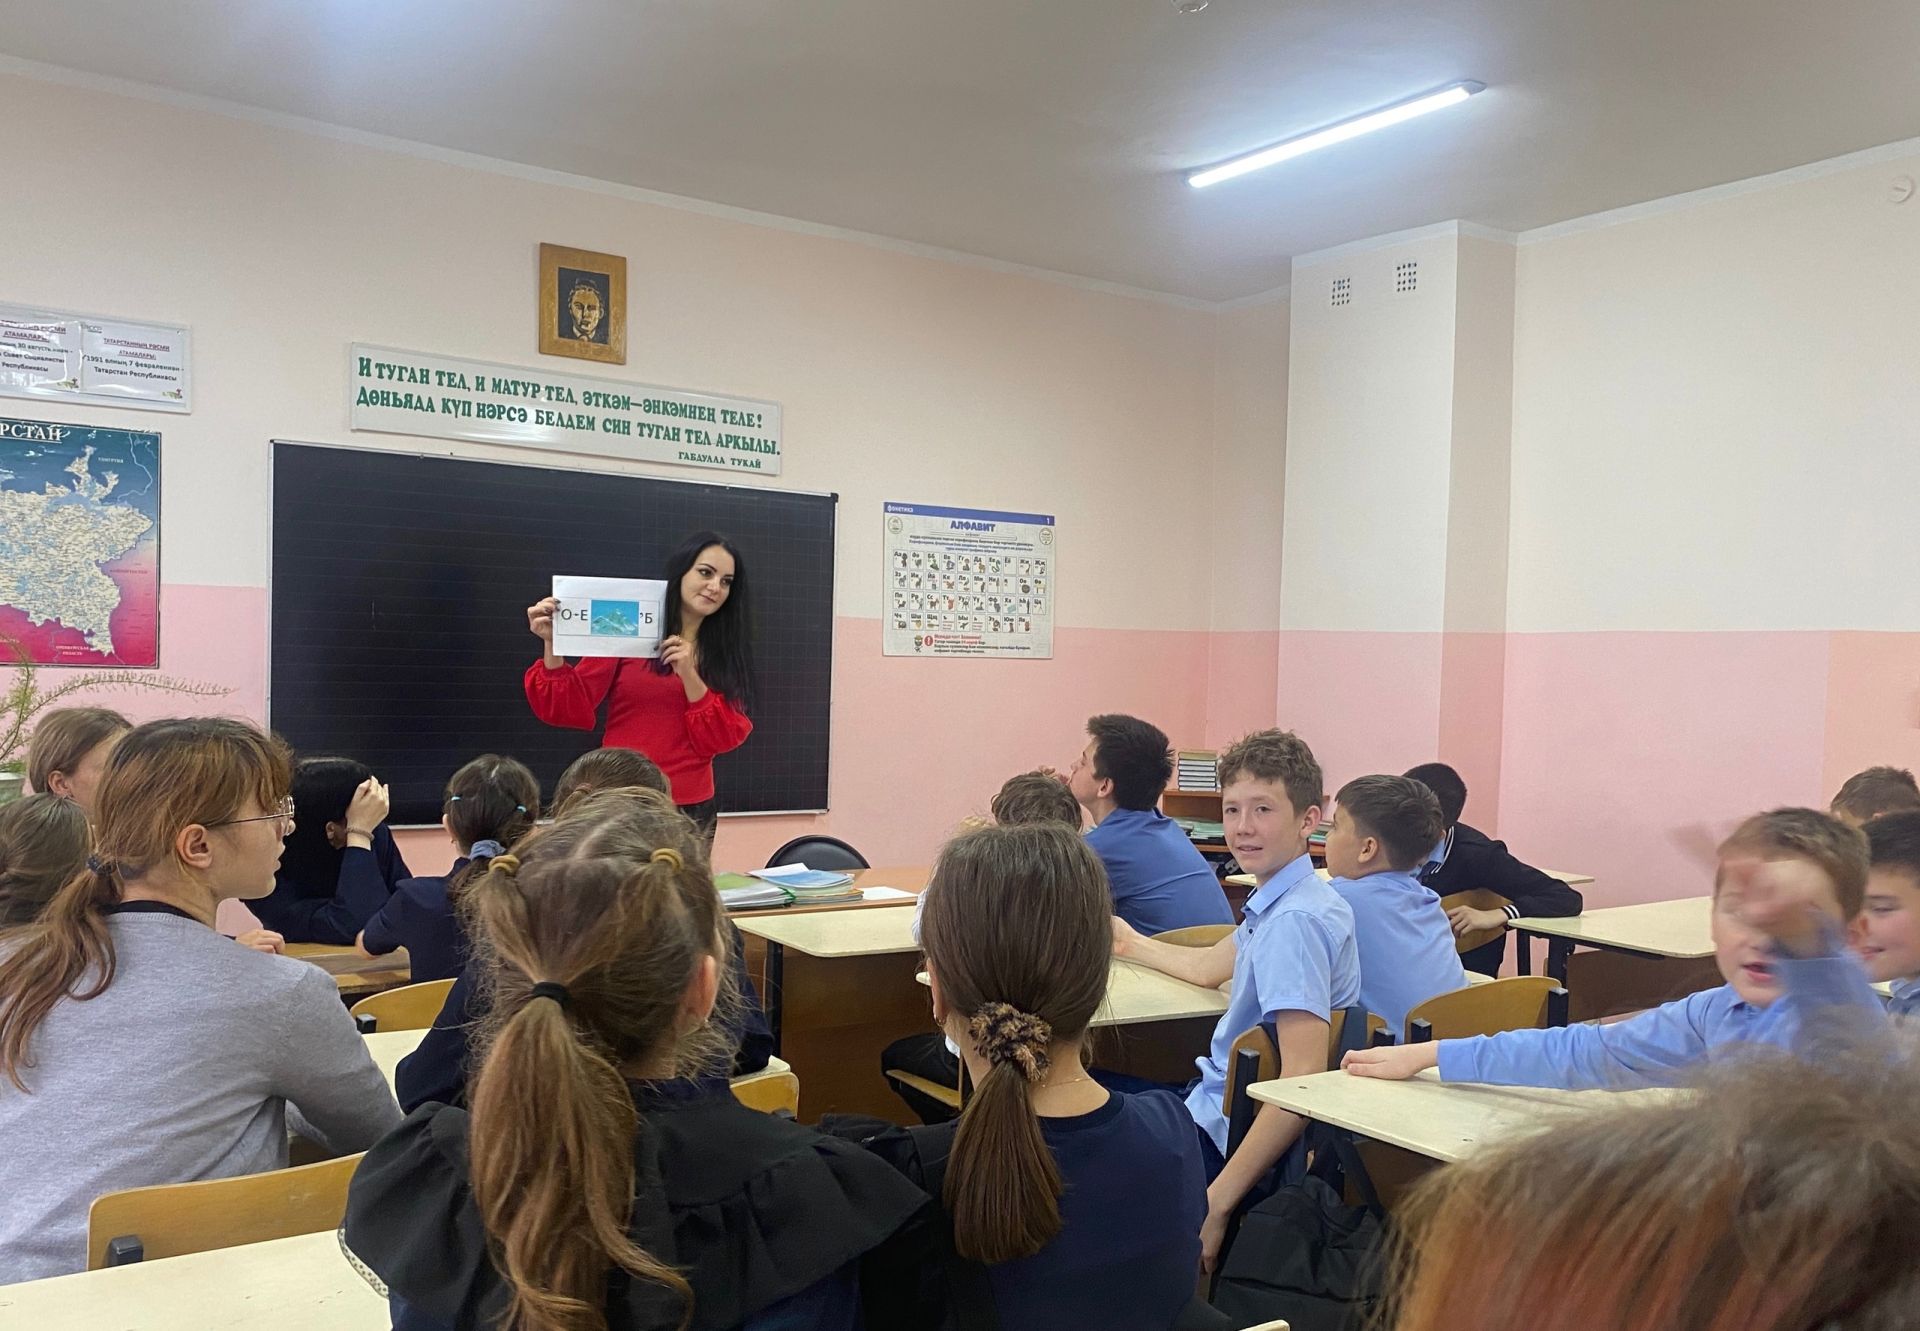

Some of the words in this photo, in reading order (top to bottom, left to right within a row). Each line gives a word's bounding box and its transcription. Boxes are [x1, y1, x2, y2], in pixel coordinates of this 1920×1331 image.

[87, 355, 103, 363] 1991
[94, 366, 128, 376] Татарстан
[129, 370, 177, 381] Республикасы
[358, 357, 372, 377] И
[375, 363, 430, 385] ТУГАН
[435, 370, 471, 392] ТЕЛ,
[475, 376, 486, 392] И
[492, 377, 541, 398] МАТУР
[544, 385, 578, 406] ТЕЛ,
[720, 409, 763, 428] ТЕЛЕ!
[356, 386, 436, 413] ДӨНЬЯДА
[441, 397, 472, 418] КҮП
[476, 403, 528, 423] НӘРСӘ
[535, 409, 596, 431] БЕЛДЕМ
[602, 418, 631, 435] СИН
[637, 422, 680, 442] ТУГАН
[685, 429, 712, 446] ТЕЛ
[716, 434, 781, 455] АРКЫЛЫ.
[678, 452, 725, 465] ГАБДУЛЛА
[730, 457, 762, 469] ТУКАЙ
[950, 520, 996, 532] АЛФАВИТ
